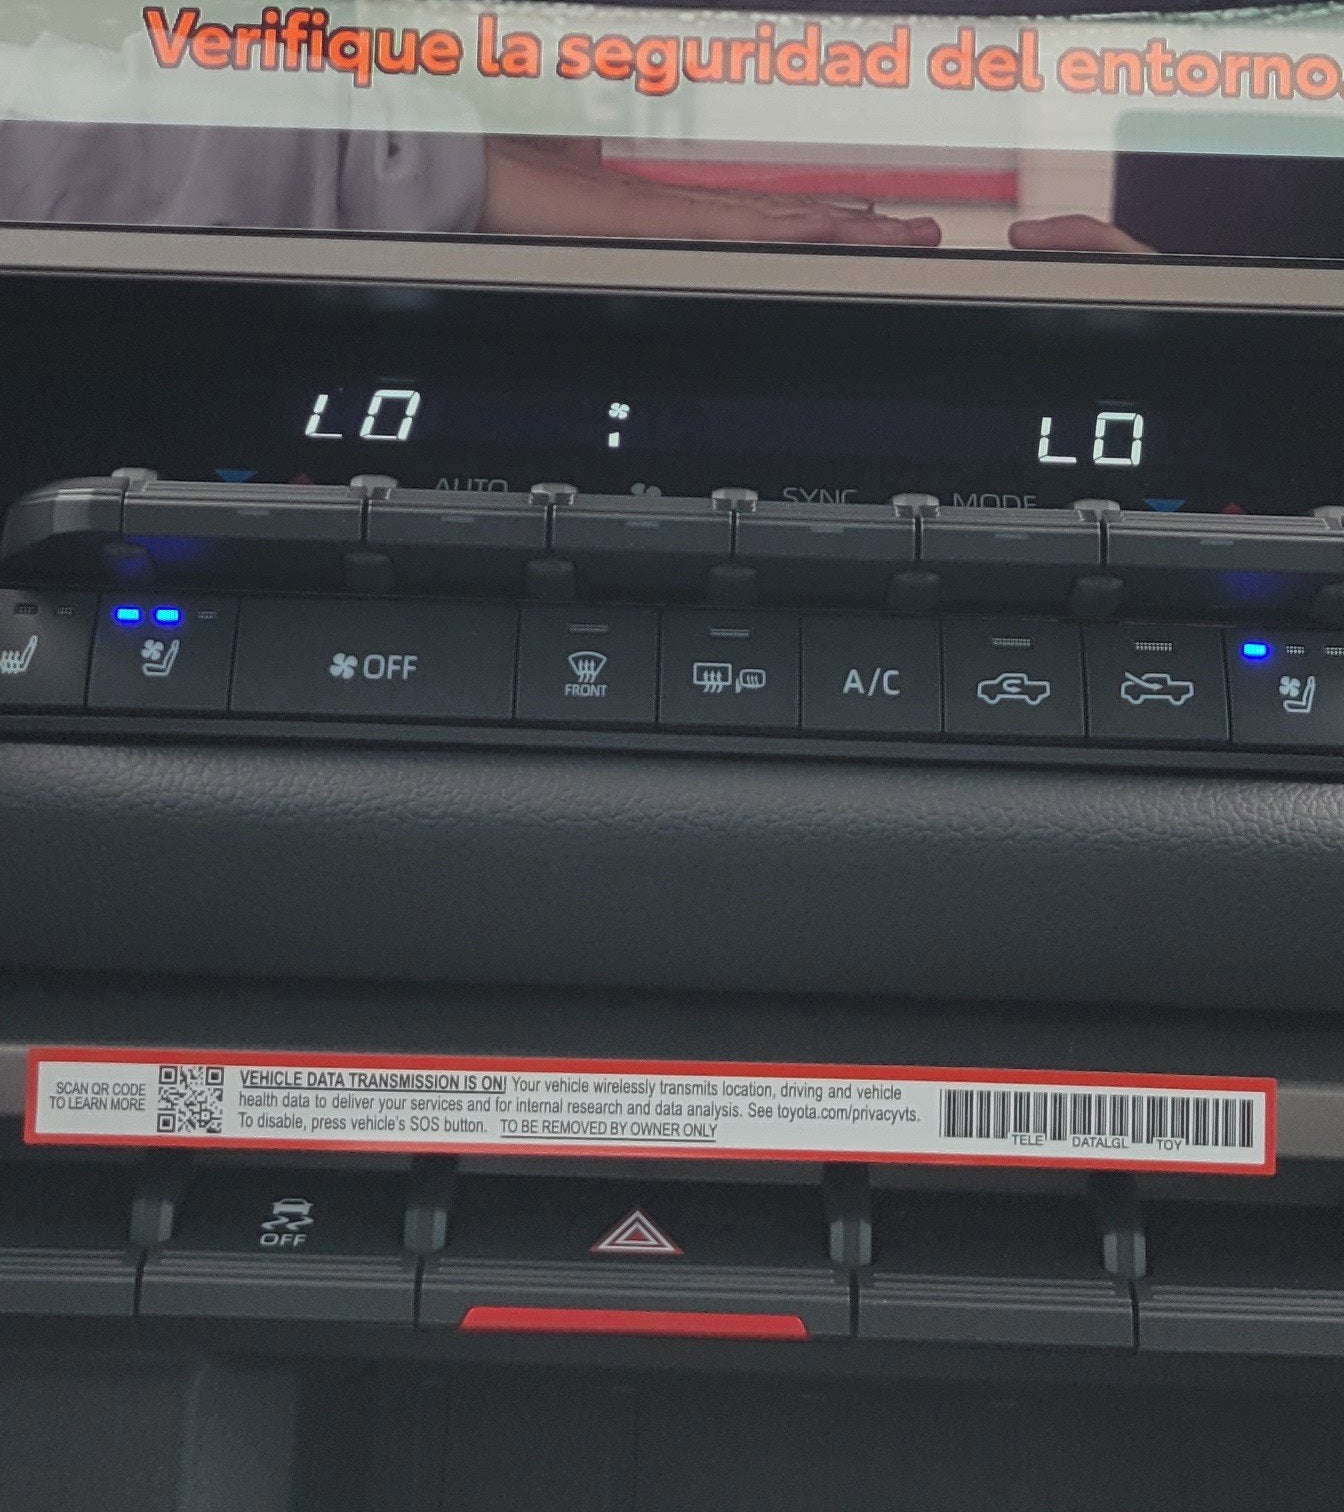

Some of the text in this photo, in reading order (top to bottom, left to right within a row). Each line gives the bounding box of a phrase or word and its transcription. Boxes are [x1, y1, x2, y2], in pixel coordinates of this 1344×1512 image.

[144, 6, 463, 88] Verifique
[477, 11, 542, 78] la
[557, 20, 911, 96] seguridad
[927, 27, 1045, 91] del
[362, 653, 418, 680] OFF
[564, 683, 608, 698] FRONT
[842, 667, 901, 697] A/C
[56, 1081, 146, 1097] SCAN QR CODE
[240, 1069, 902, 1102] VEHICLE DATA TRANSMISSION IS ON! Your vehicle wirelessly transmits location, driving and vehicle
[49, 1095, 146, 1111] TO LEARN MORE
[238, 1090, 921, 1125] health data to deliver your services and for internal research and data analysis. See toyota.com/privacyvts.
[238, 1111, 488, 1133] To disable, press vehicle's SOS button.
[500, 1118, 718, 1138] TO BE REMOVED BY OWNER ONLY
[1011, 1133, 1183, 1151] TELE DATALGL TOY
[259, 1232, 308, 1247] OFF
